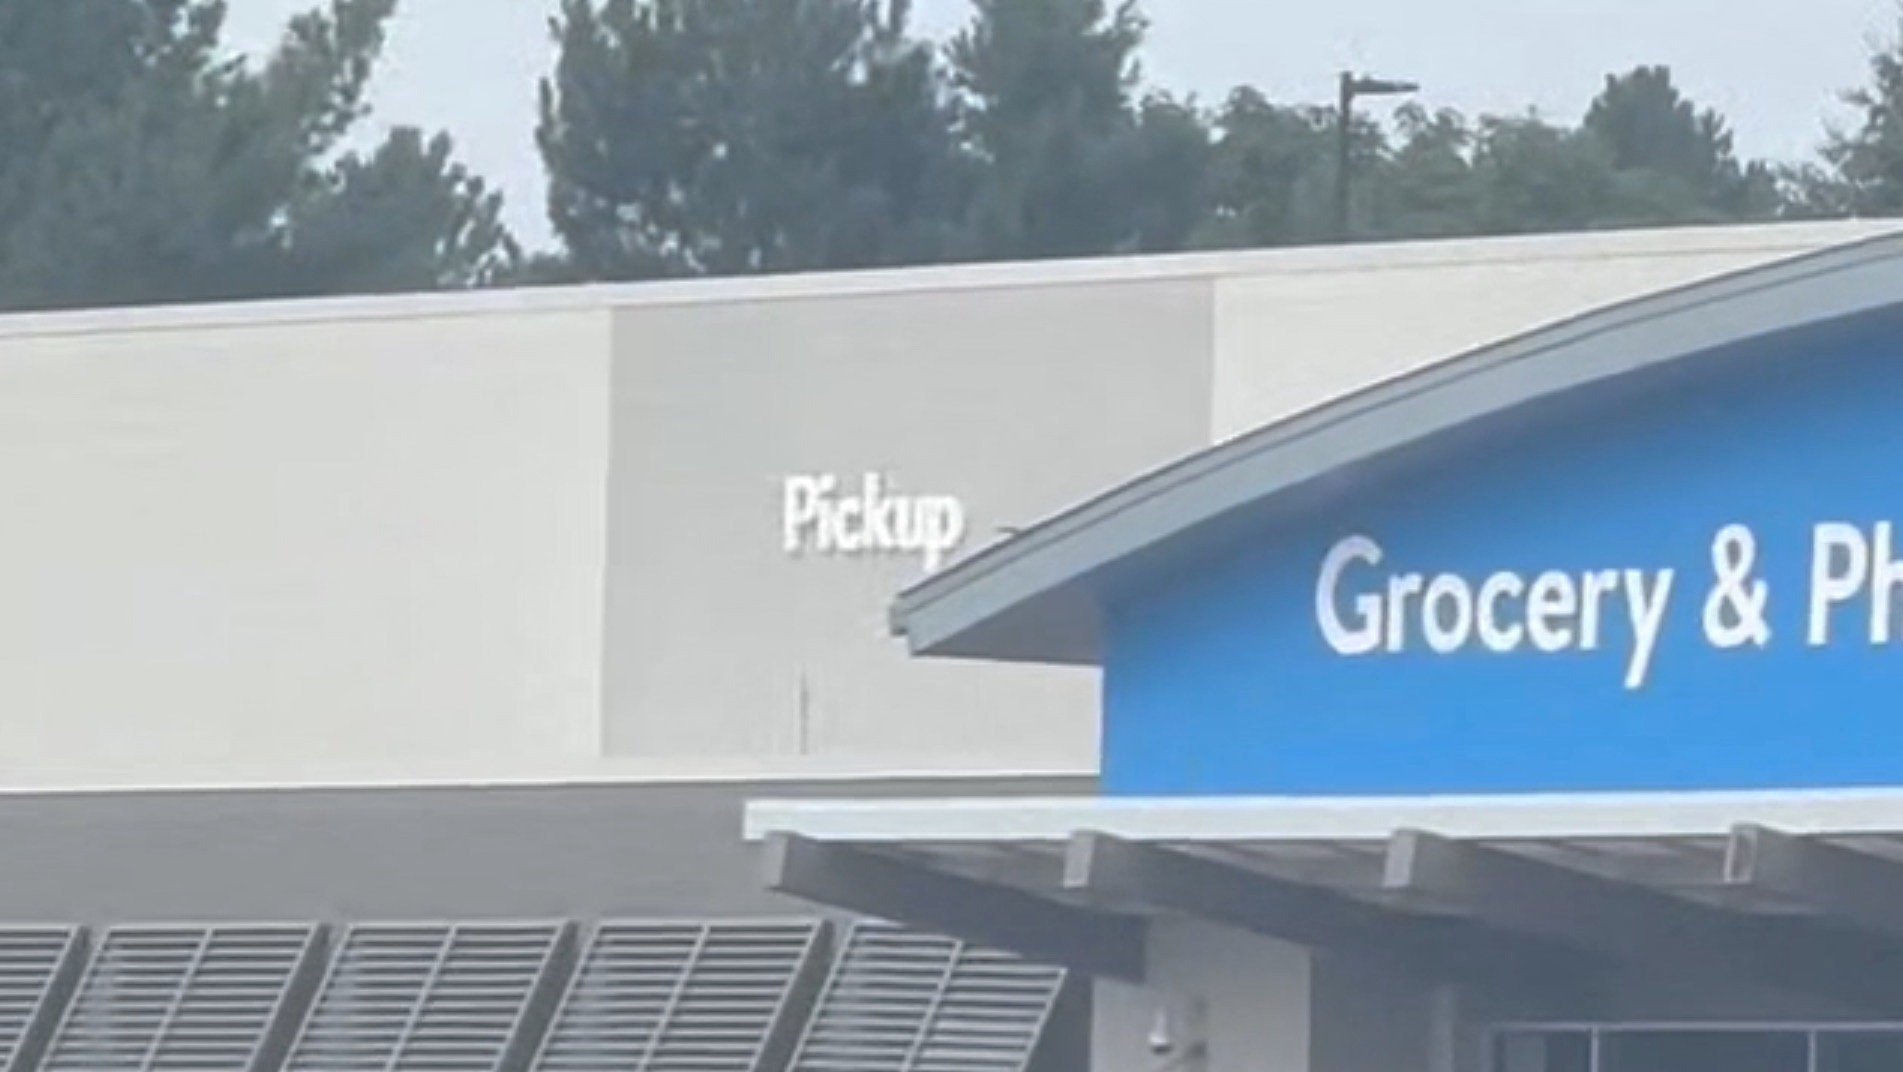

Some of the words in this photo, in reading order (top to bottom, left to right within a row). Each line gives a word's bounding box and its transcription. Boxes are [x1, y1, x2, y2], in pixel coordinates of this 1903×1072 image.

[784, 472, 964, 569] Pickup
[1315, 534, 1674, 689] Grocery
[1701, 523, 1772, 648] &
